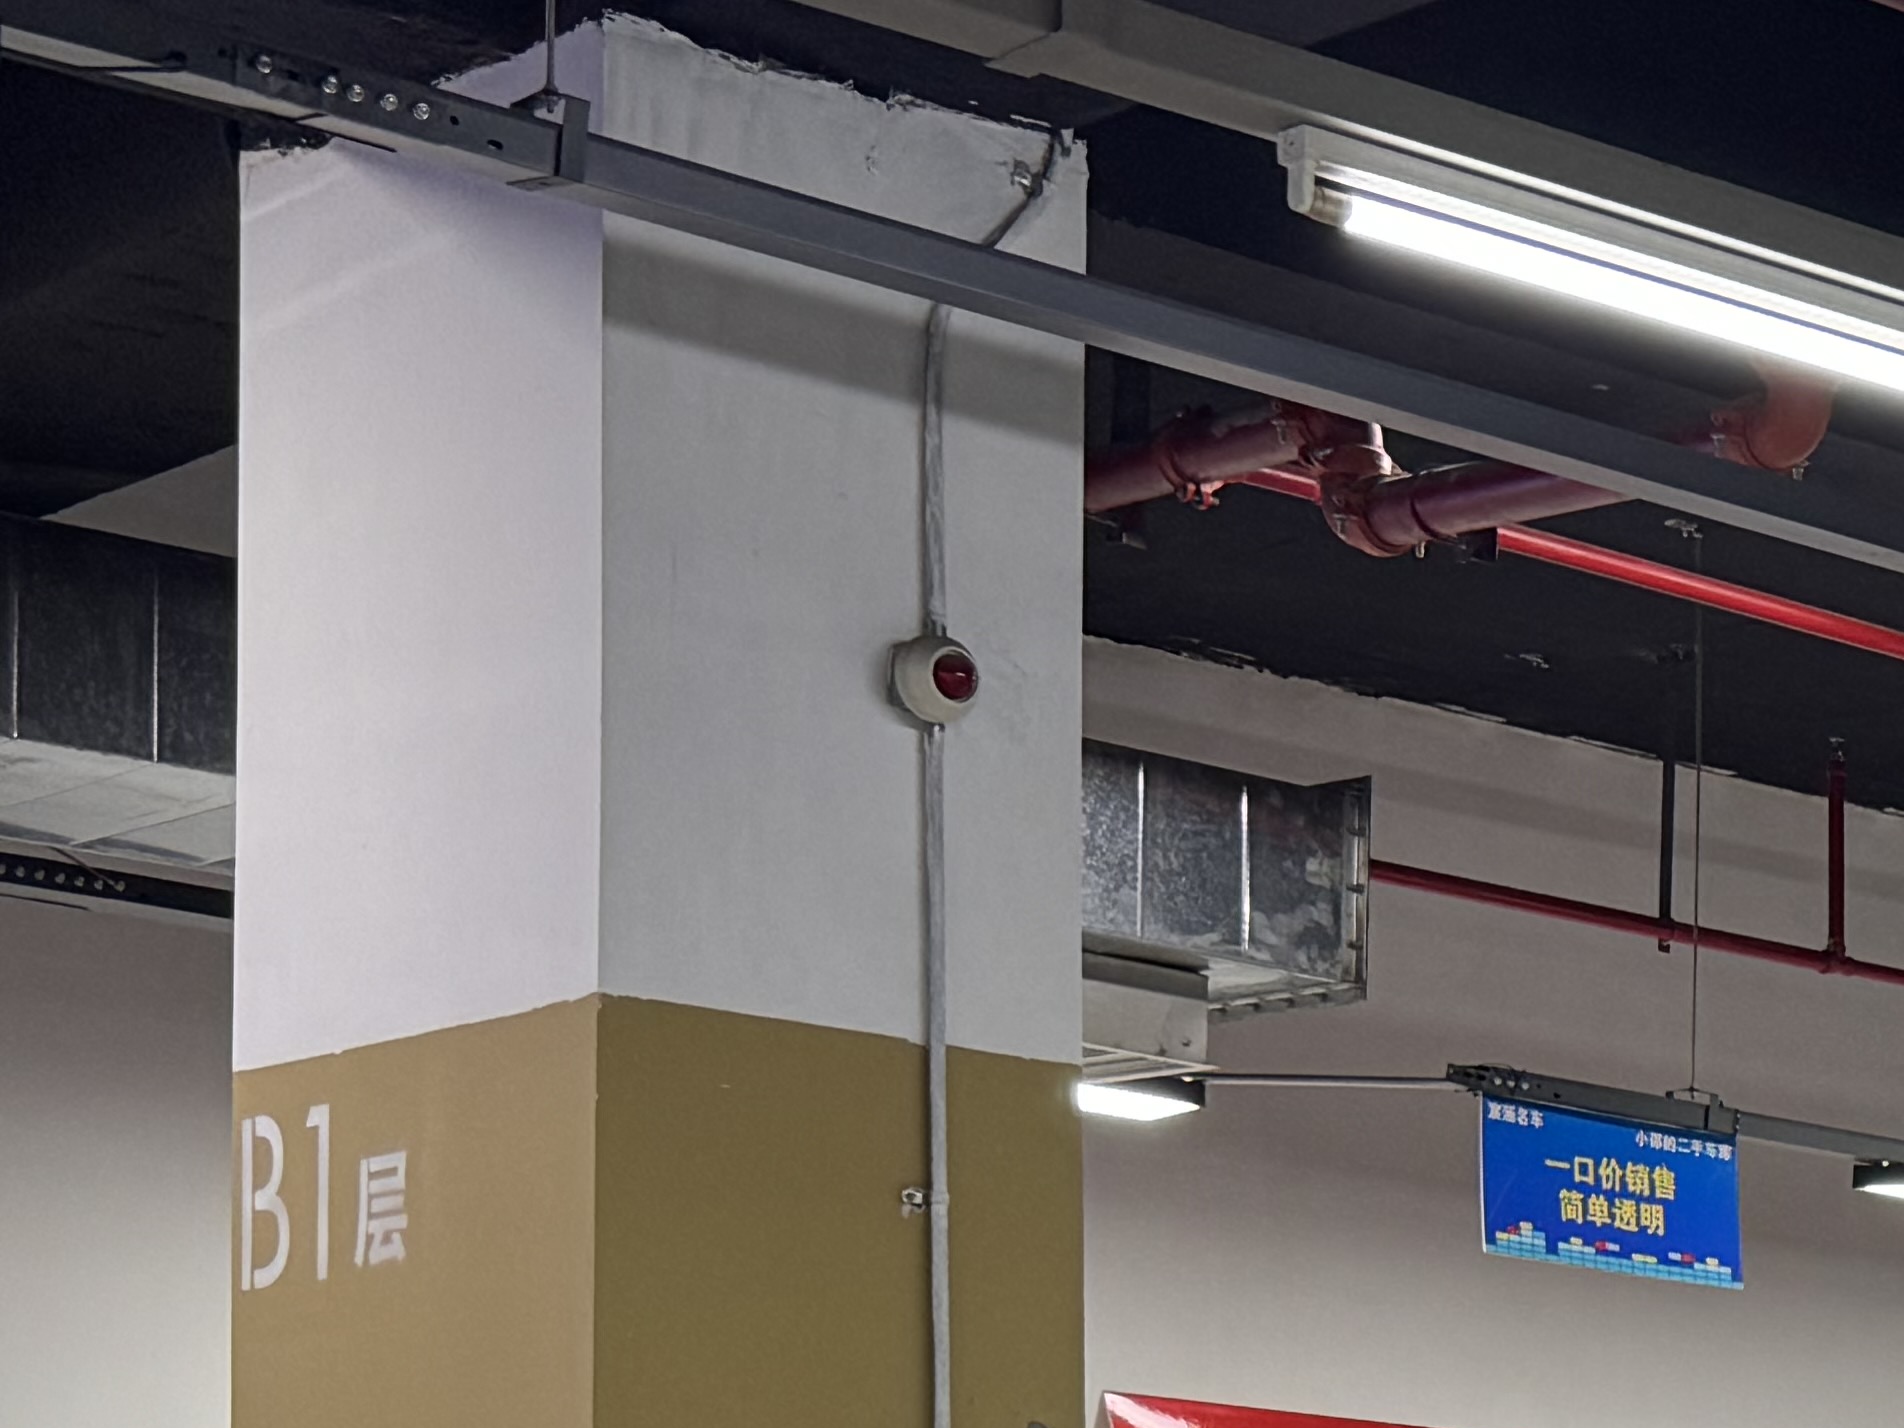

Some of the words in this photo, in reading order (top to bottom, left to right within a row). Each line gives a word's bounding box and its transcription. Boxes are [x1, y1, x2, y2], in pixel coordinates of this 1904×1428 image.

[241, 1103, 407, 1291] B1层
[1544, 1156, 1676, 1200] 一口价销售
[1559, 1188, 1665, 1236] 简单透明
